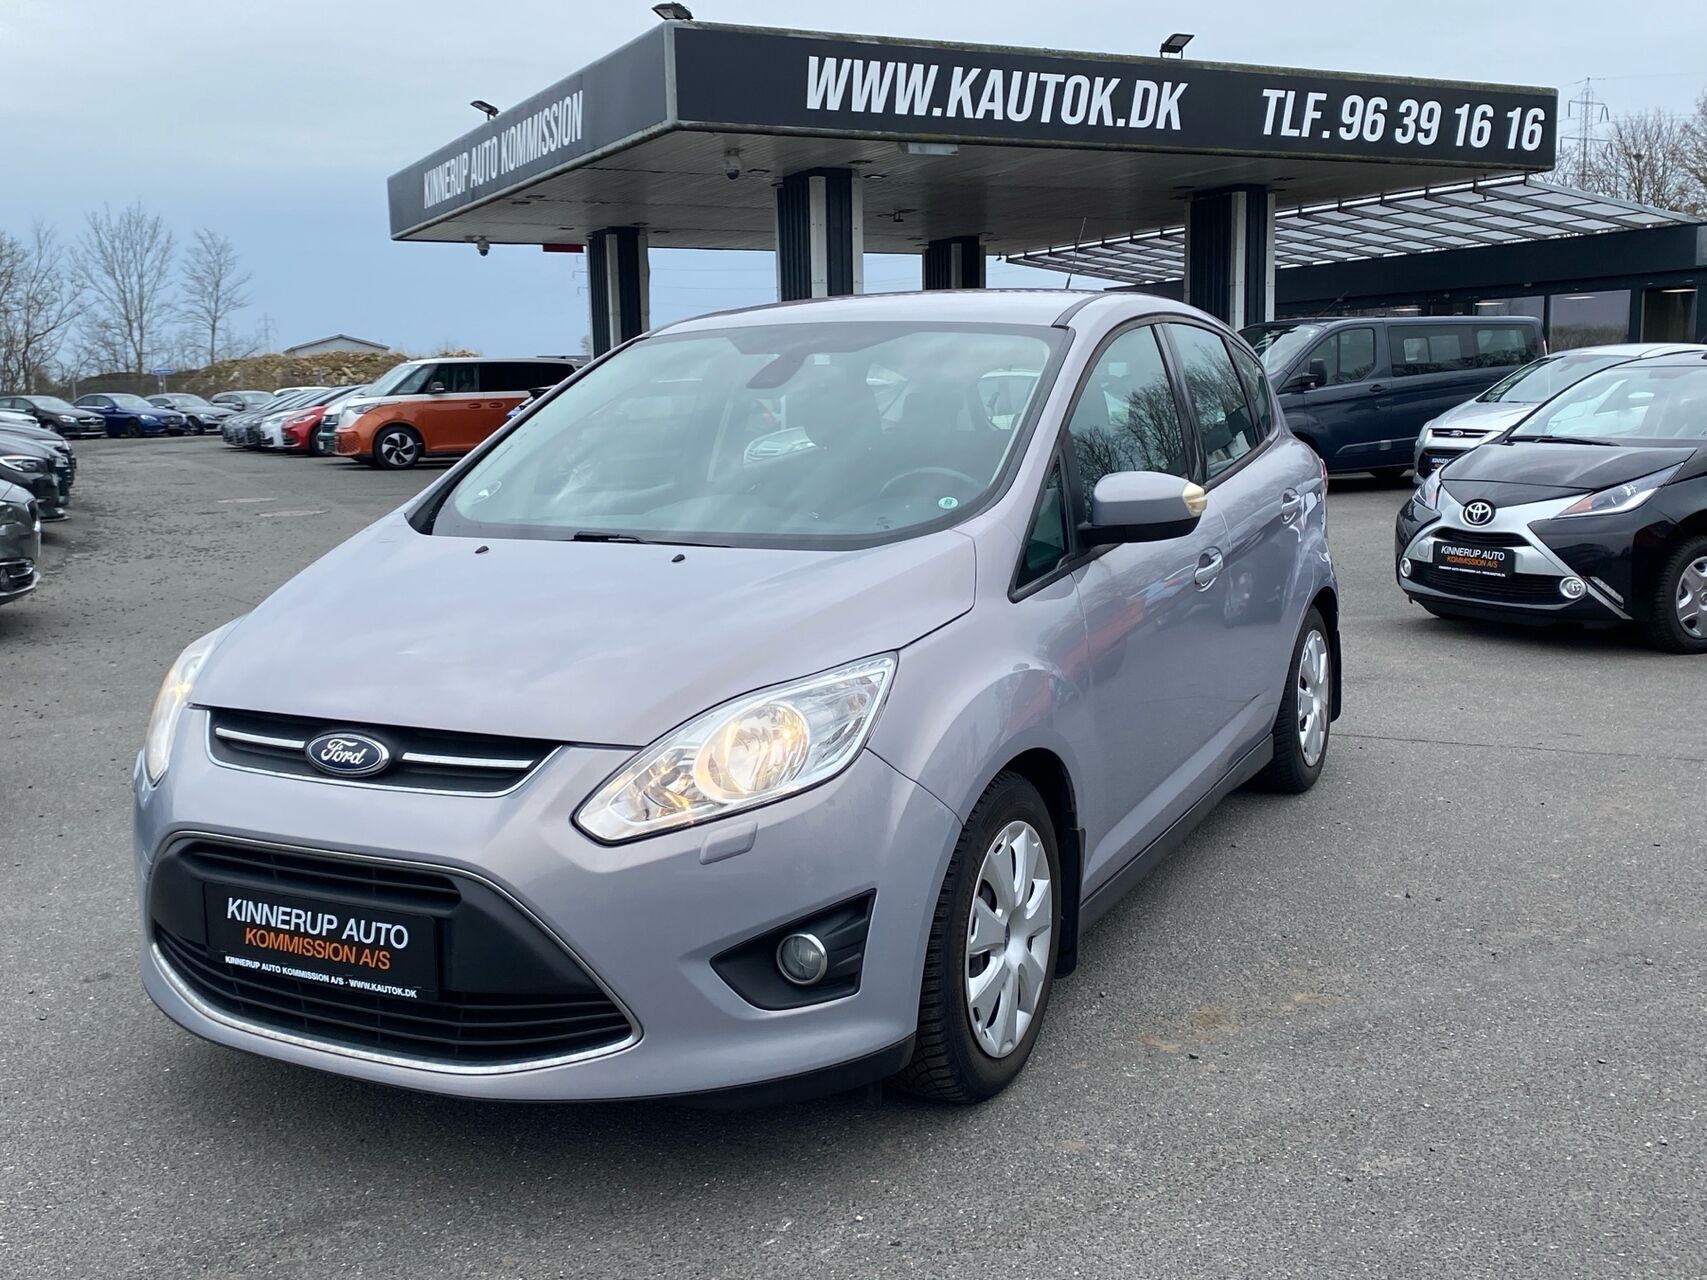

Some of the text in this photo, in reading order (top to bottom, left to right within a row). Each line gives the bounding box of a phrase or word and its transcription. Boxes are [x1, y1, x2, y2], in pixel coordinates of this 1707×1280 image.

[806, 55, 1189, 131] WWW.KAUTOK.DK
[1260, 88, 1545, 151] TLF. 96 39 16 16
[424, 90, 584, 209] KINNERUP AUTO KOMMISSION
[1441, 546, 1504, 560] KINNERUP AUTO
[1447, 556, 1486, 566] KOMMISSION
[320, 738, 368, 765] Ford
[226, 897, 409, 950] KINNERUP AUTO
[244, 927, 391, 970] KOMMISSION A/S
[225, 955, 260, 969] KINNERUP
[261, 962, 282, 974] AUTO
[282, 966, 329, 983] KOMMISSION
[330, 975, 345, 986] A/S
[349, 978, 418, 999] WWW.KAUTOK.DK
